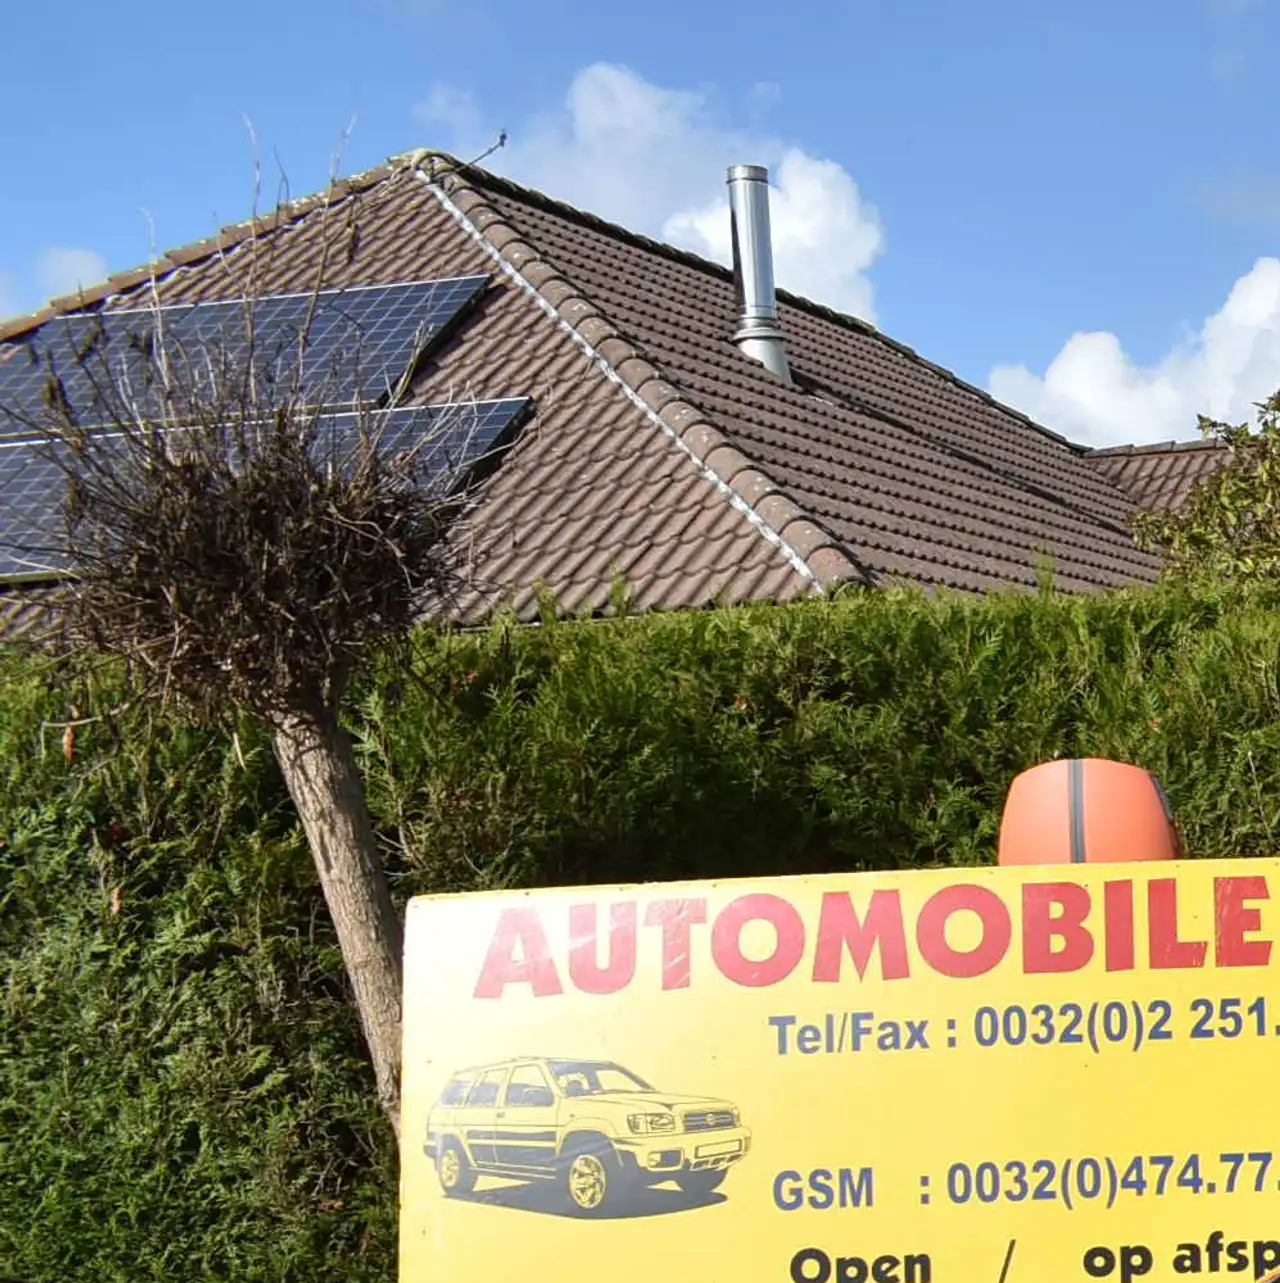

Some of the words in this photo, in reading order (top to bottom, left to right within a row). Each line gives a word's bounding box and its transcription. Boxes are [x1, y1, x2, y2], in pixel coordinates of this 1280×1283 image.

[472, 875, 1273, 999] AUTOMOBILE
[768, 1011, 930, 1055] Tel/Fax
[974, 999, 1173, 1054] 0032(0)2
[773, 1168, 874, 1211] GSM
